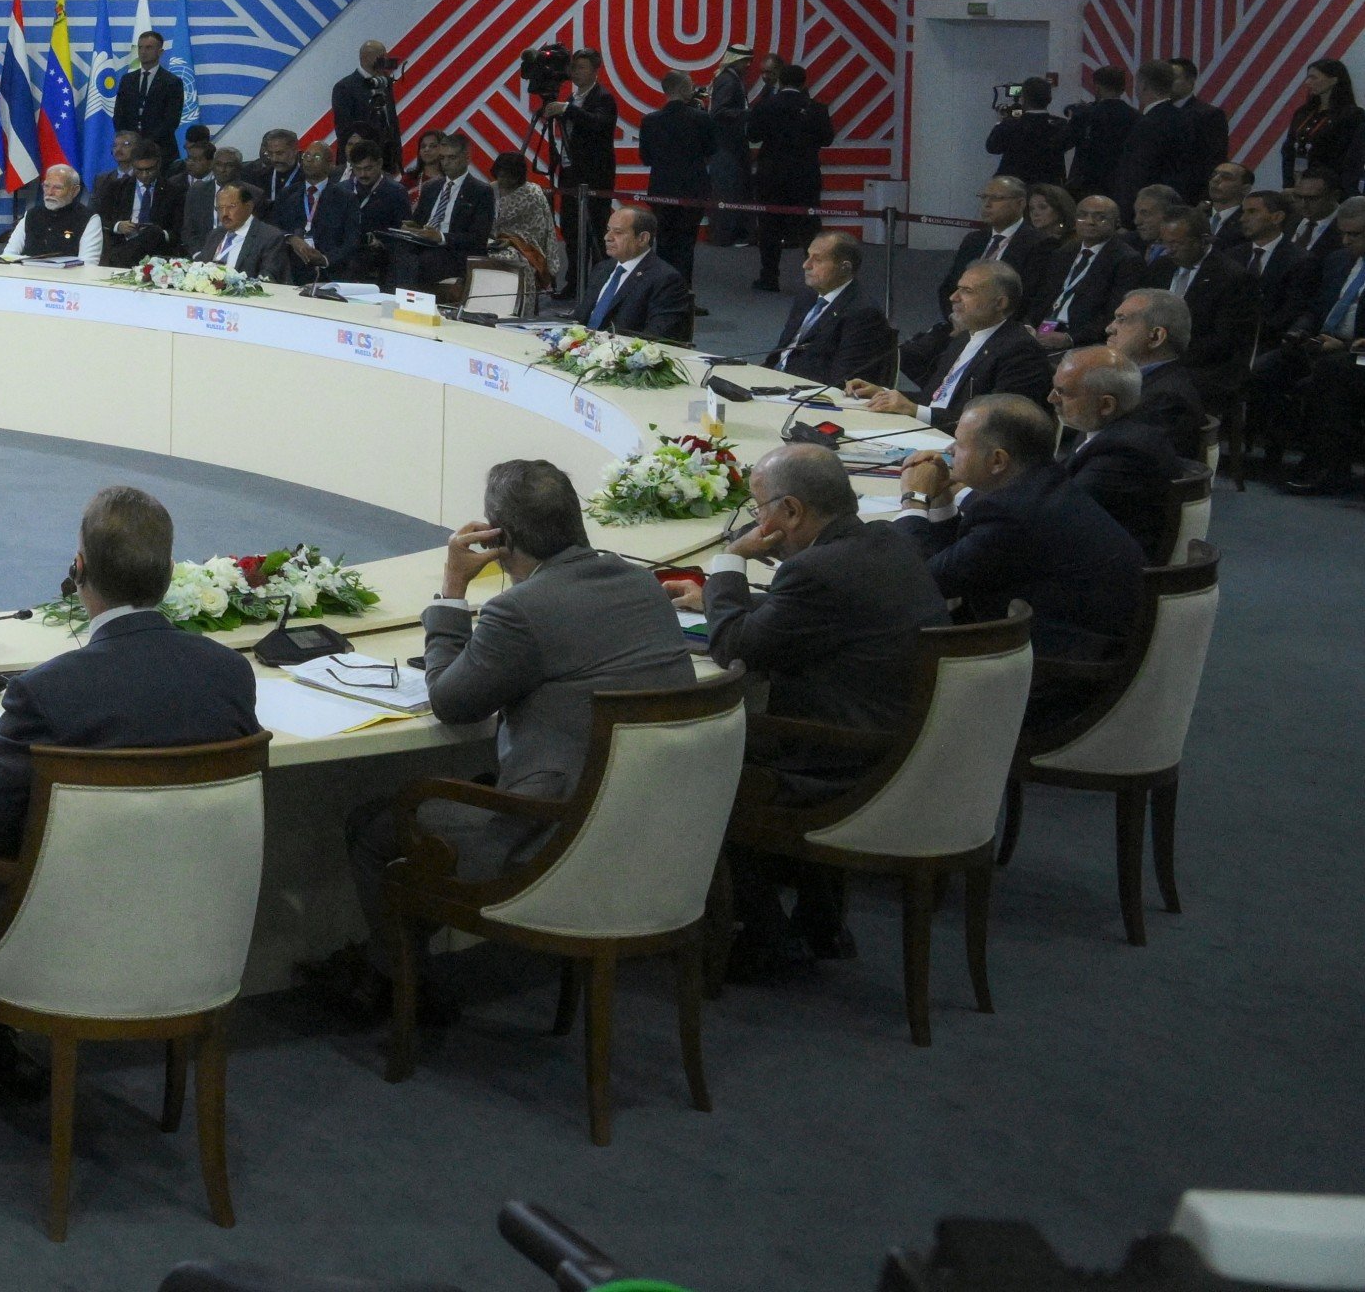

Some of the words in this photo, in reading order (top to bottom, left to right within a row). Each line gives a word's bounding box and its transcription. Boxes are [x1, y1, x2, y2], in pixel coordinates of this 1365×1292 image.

[66, 301, 80, 311] 24
[226, 322, 239, 333] 24
[372, 349, 384, 360] 24
